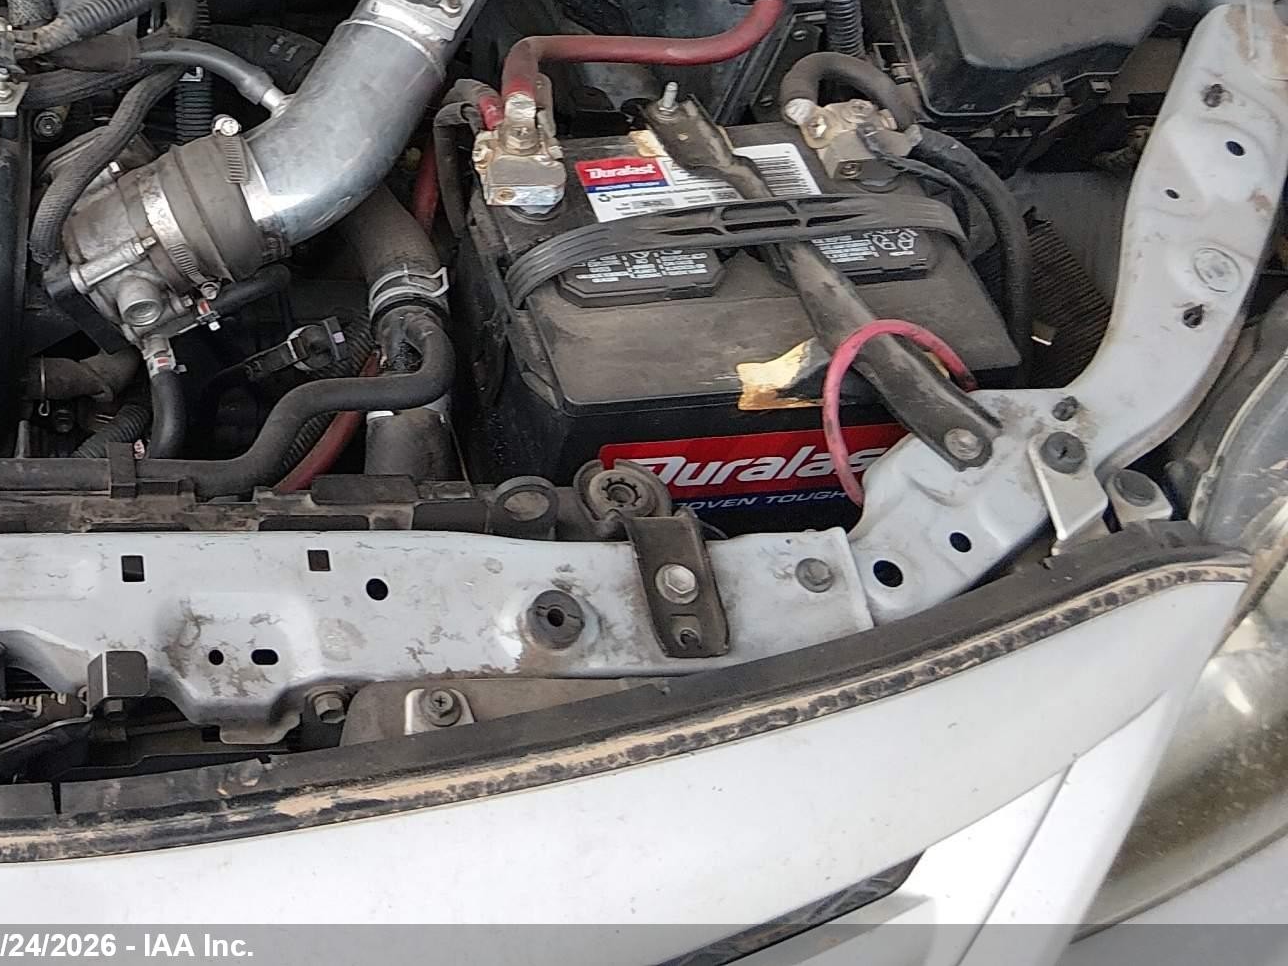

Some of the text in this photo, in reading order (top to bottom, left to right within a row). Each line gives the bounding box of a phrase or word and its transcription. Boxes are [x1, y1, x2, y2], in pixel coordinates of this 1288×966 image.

[584, 164, 656, 179] Duralast
[632, 445, 888, 487] Duralas
[766, 490, 848, 504] TOUGH
